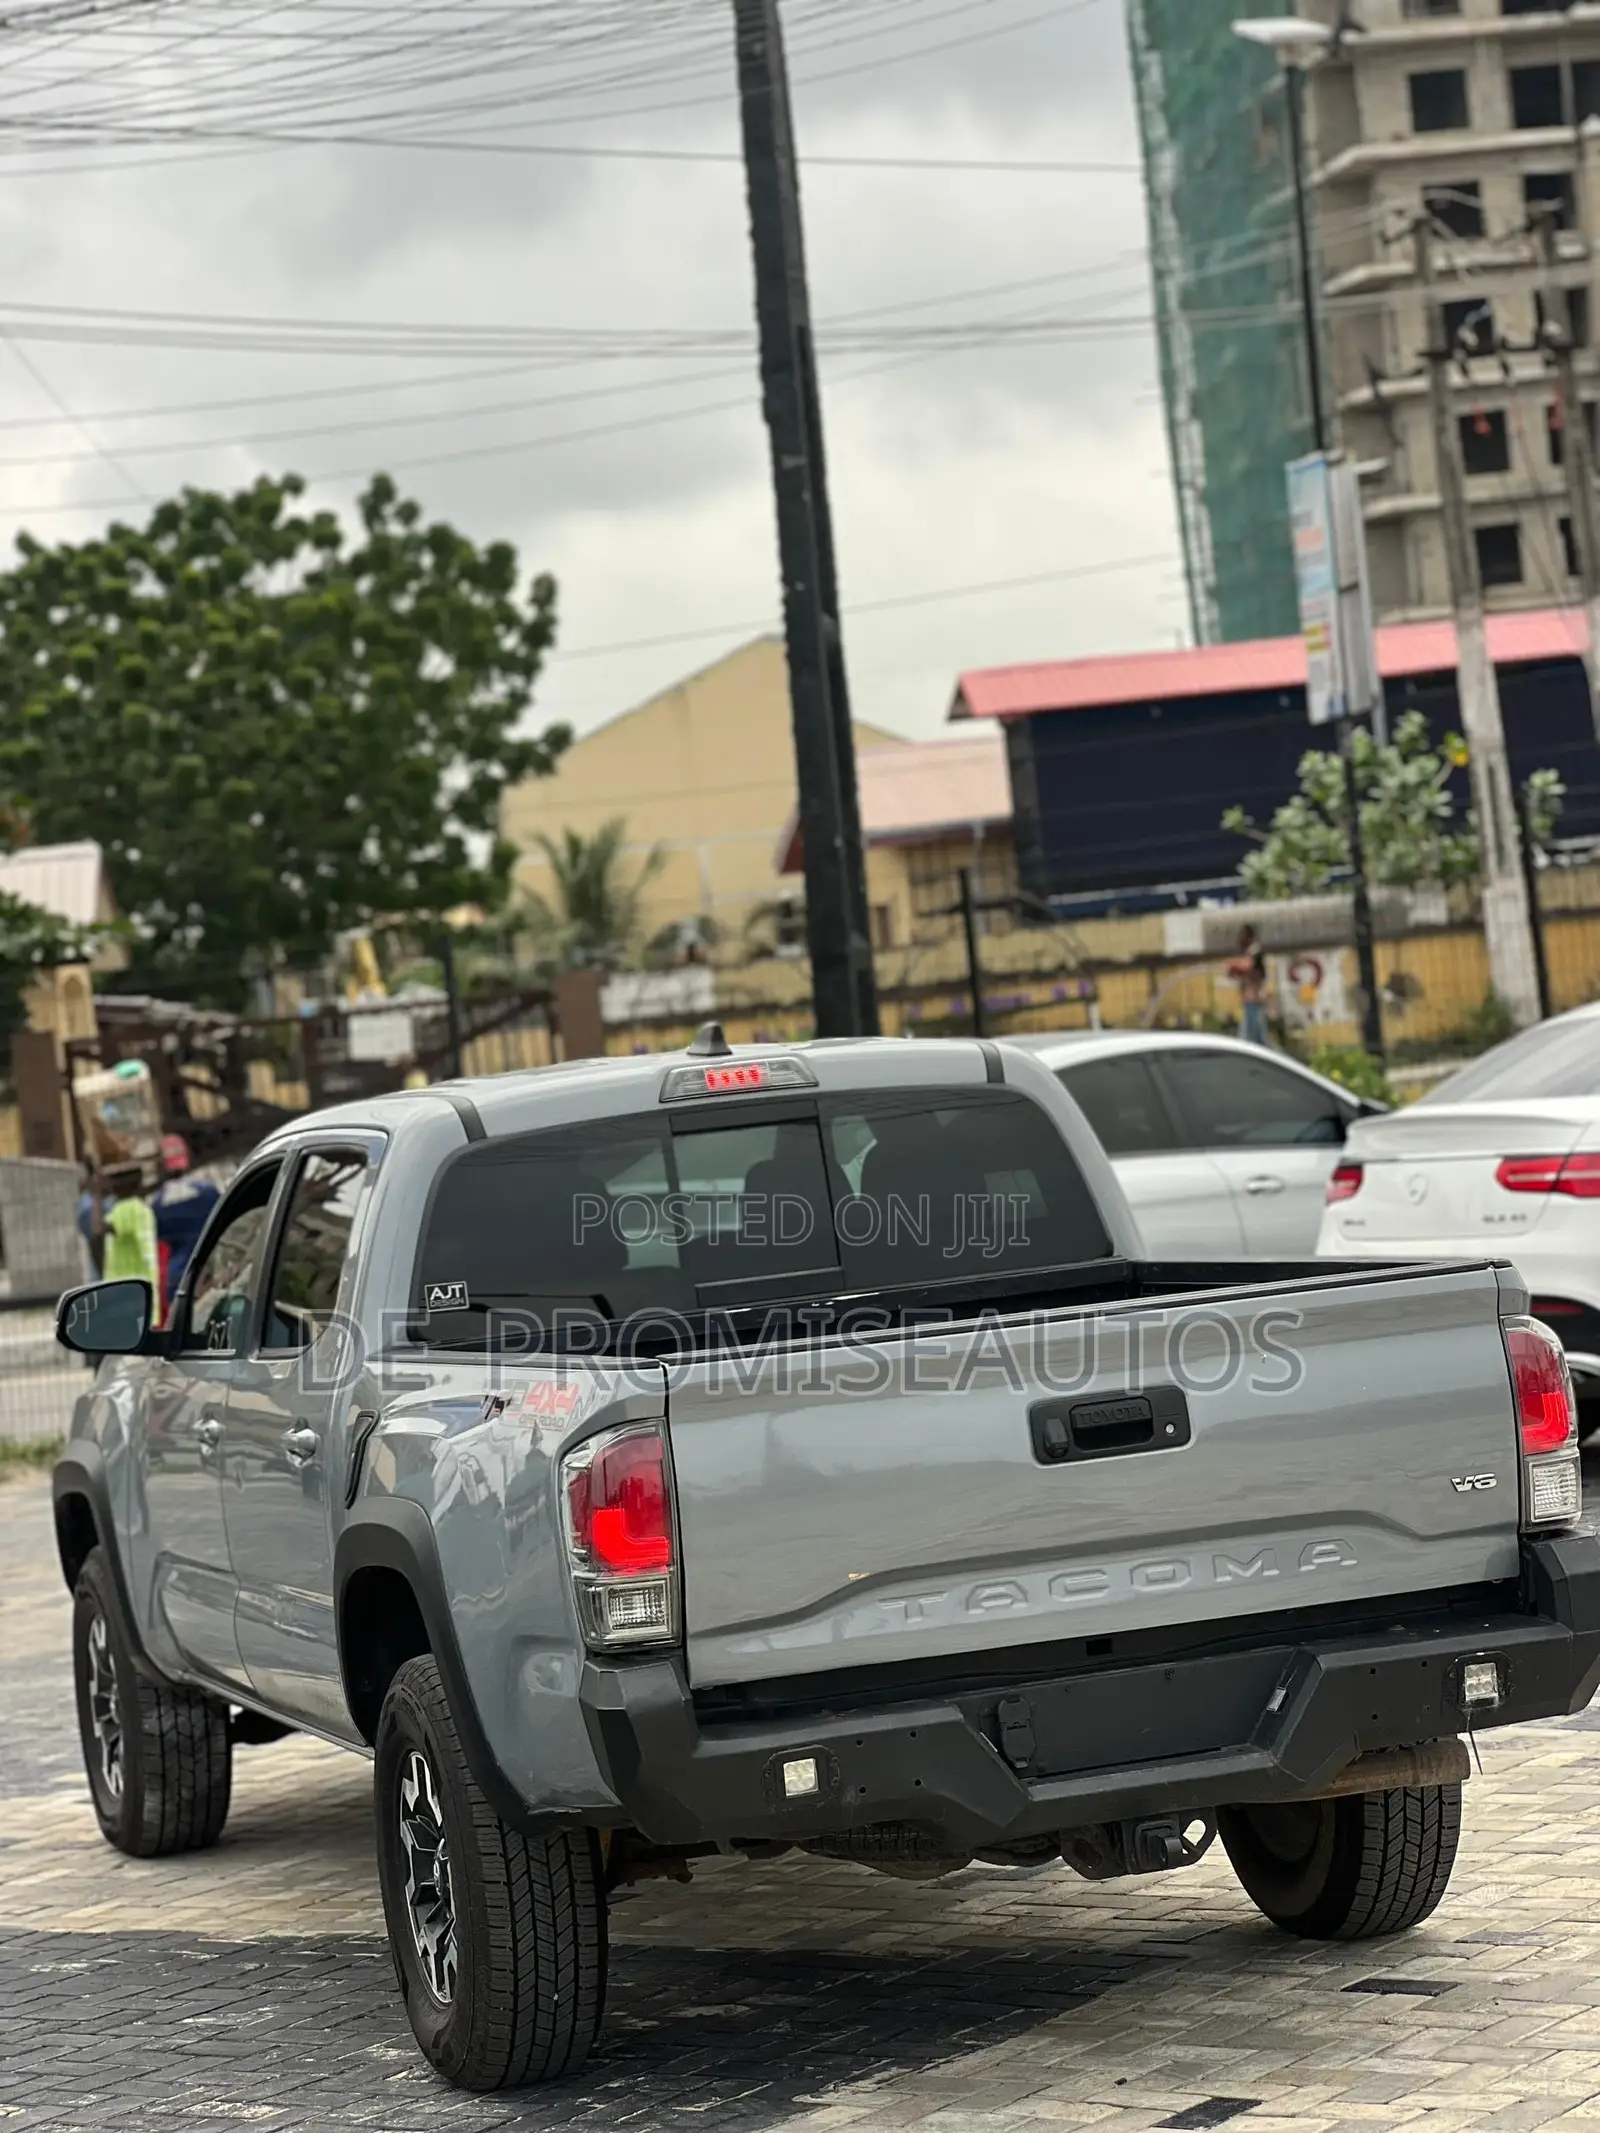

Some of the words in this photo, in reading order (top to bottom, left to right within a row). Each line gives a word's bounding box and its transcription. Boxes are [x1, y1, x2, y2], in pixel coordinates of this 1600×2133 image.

[430, 1284, 463, 1300] AJT
[1079, 1403, 1147, 1424] TOYOTA
[1450, 1472, 1498, 1493] V6
[877, 1538, 1358, 1623] TACOMA
